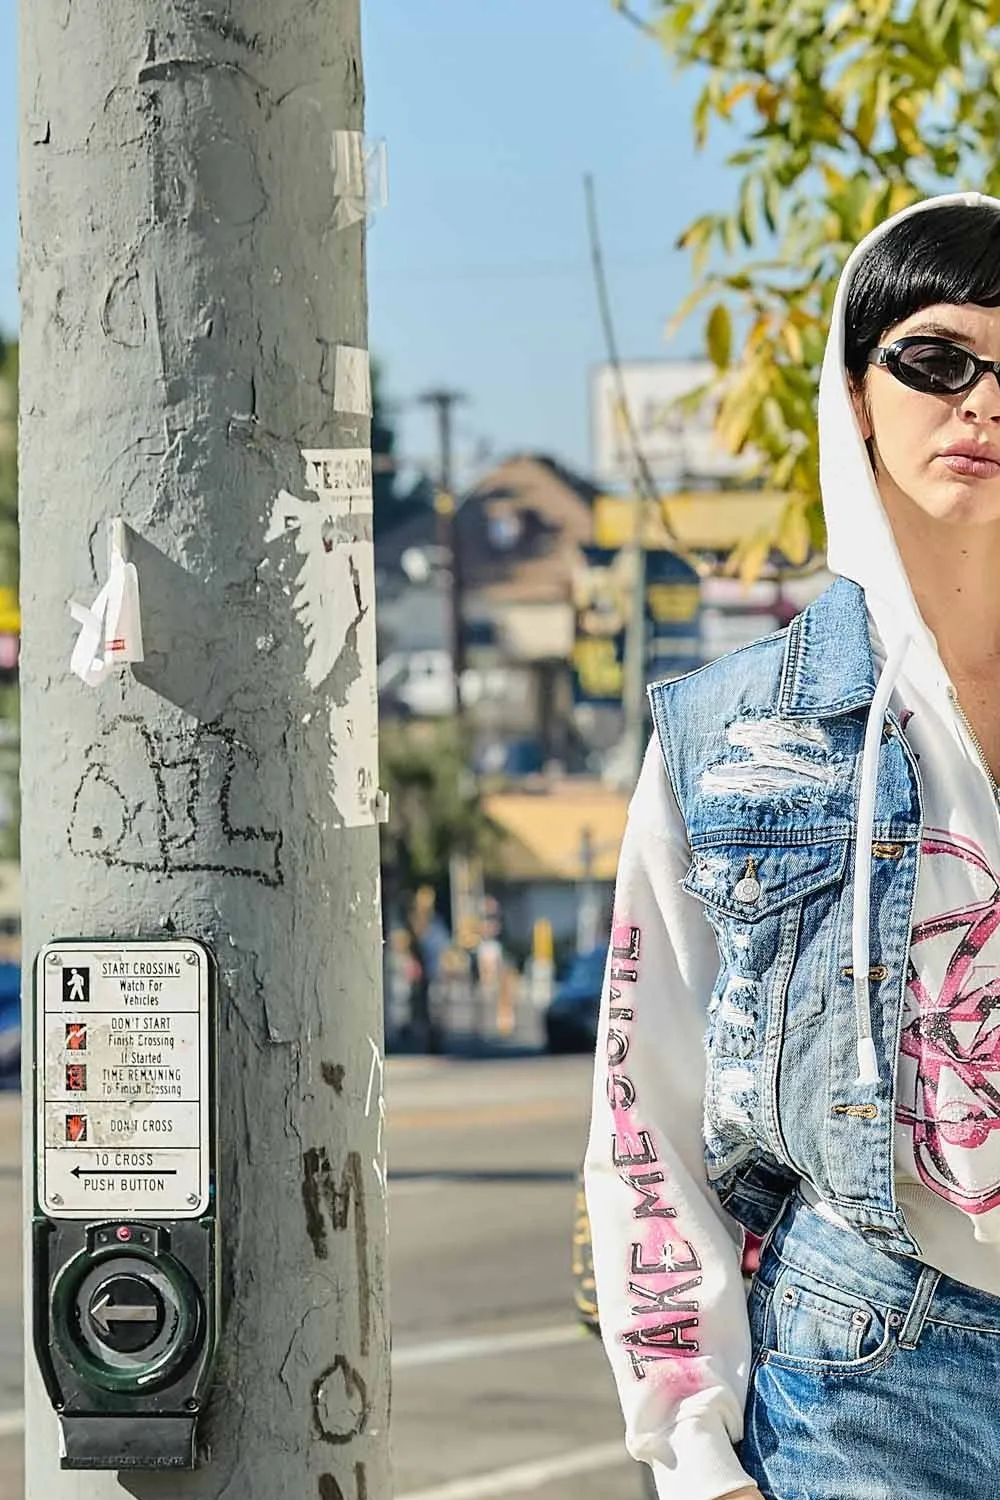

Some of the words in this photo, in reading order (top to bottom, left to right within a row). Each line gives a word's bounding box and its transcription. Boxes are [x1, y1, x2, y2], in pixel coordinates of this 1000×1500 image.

[102, 962, 130, 975] START
[133, 962, 181, 975] CROSSING
[120, 980, 145, 992] Watch
[148, 979, 163, 992] For
[124, 994, 159, 1006] Vehicles
[111, 1017, 140, 1030] DON'T
[143, 1017, 170, 1030] START
[131, 1052, 162, 1064] Started
[103, 1069, 123, 1081] TIME
[128, 1069, 181, 1081] REMAINING
[142, 1119, 173, 1132] CROSS
[115, 1153, 153, 1166] CROSS
[611, 1130, 678, 1219] ME
[84, 1179, 115, 1191] PUSH
[120, 1179, 165, 1191] BUTTON
[619, 1239, 703, 1382] TAKE
